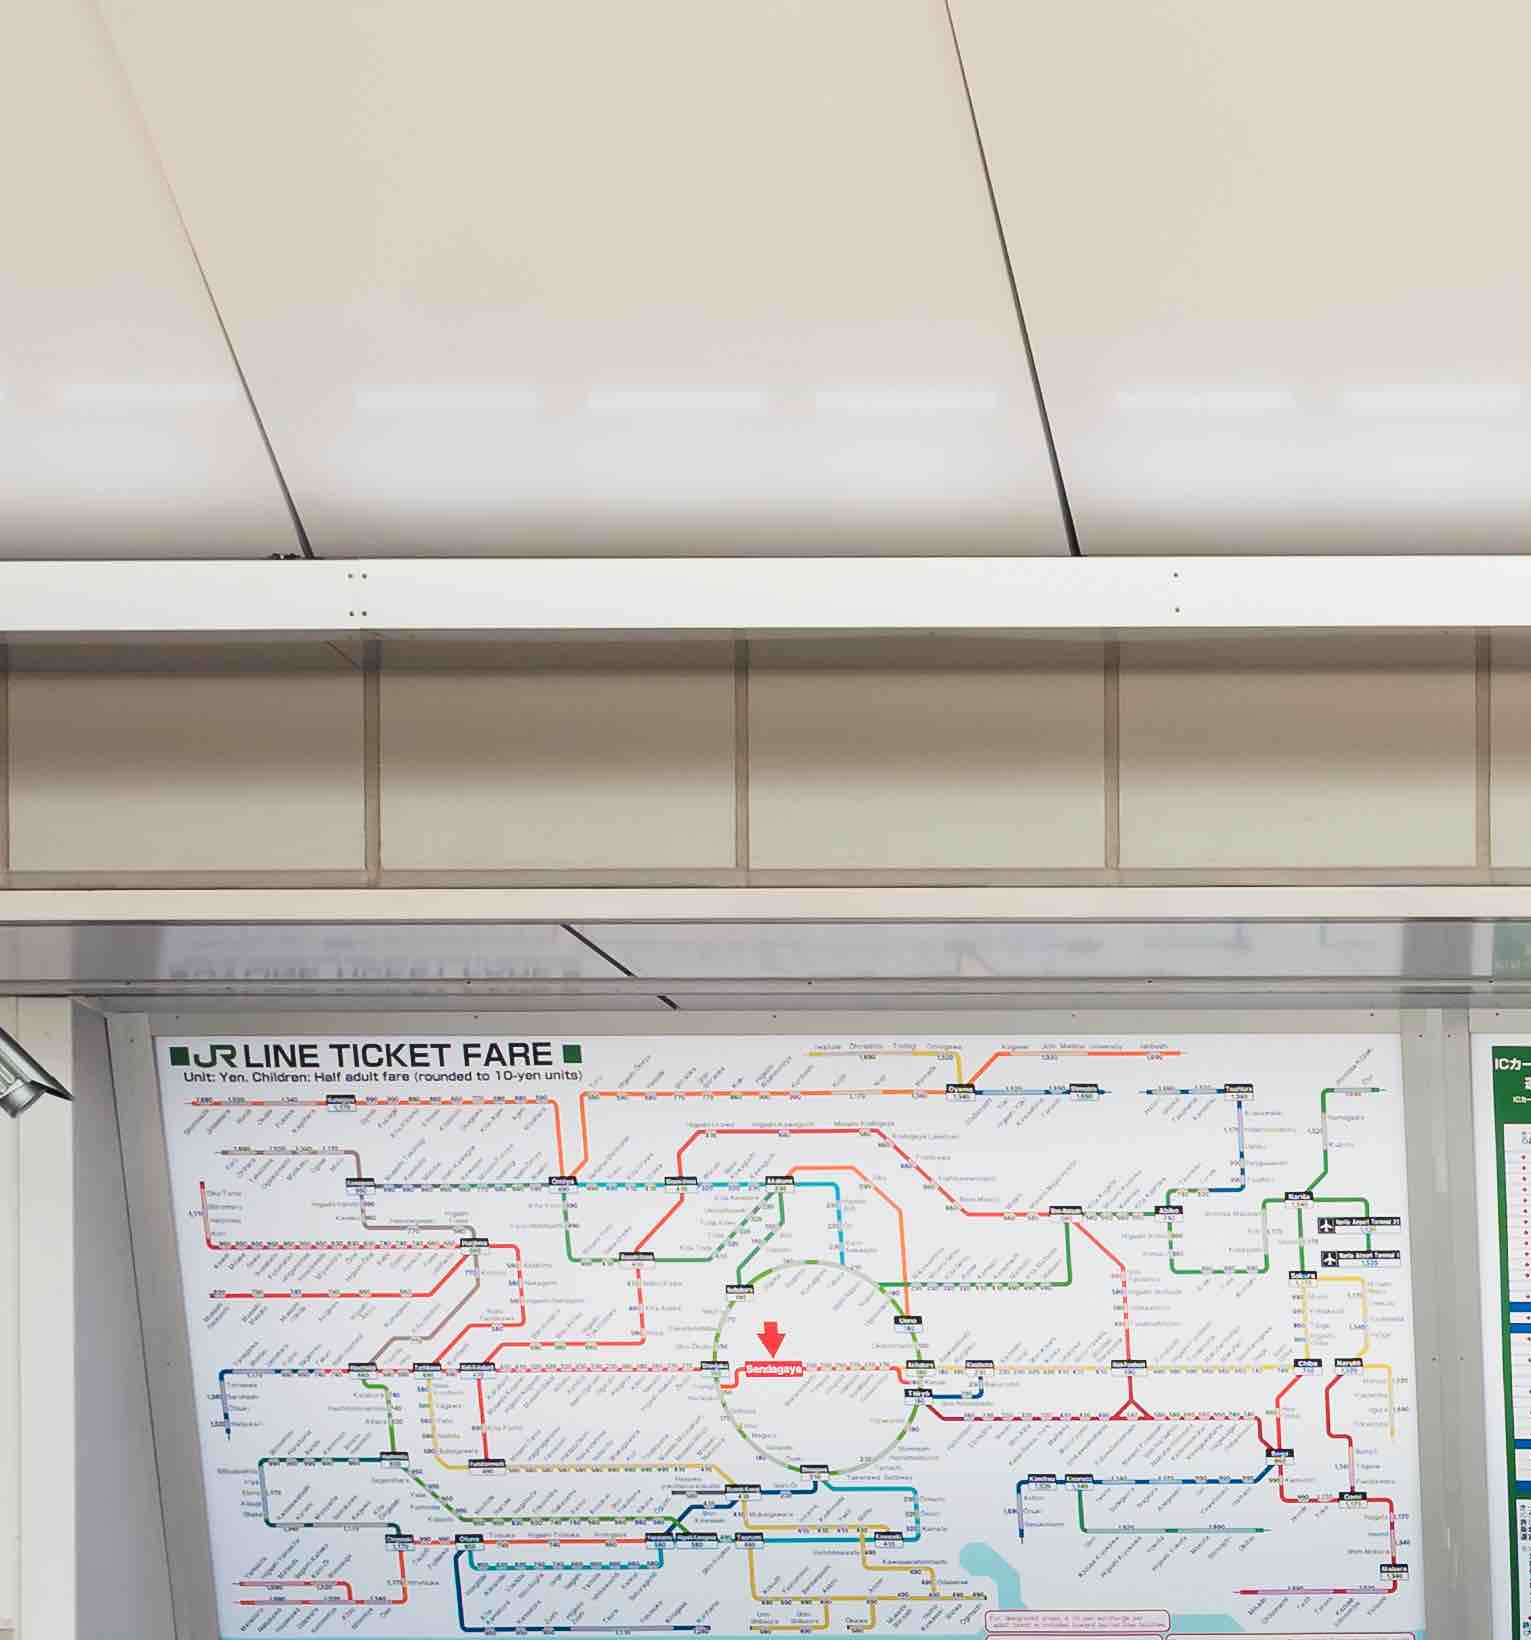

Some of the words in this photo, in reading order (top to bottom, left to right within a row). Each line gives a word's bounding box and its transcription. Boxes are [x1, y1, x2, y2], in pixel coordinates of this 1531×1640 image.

[194, 1046, 238, 1068] JR
[244, 1045, 320, 1068] LINE
[330, 1043, 453, 1068] TICKET
[463, 1043, 553, 1066] FARE
[184, 1071, 215, 1082] Unit:
[252, 1071, 310, 1082] Children:
[315, 1071, 341, 1082] Half
[345, 1071, 377, 1082] adult
[383, 1071, 409, 1081] fare
[414, 1071, 471, 1082] (rounded
[477, 1071, 490, 1081] to
[496, 1070, 541, 1082] 10-yen
[545, 1070, 582, 1081] units)
